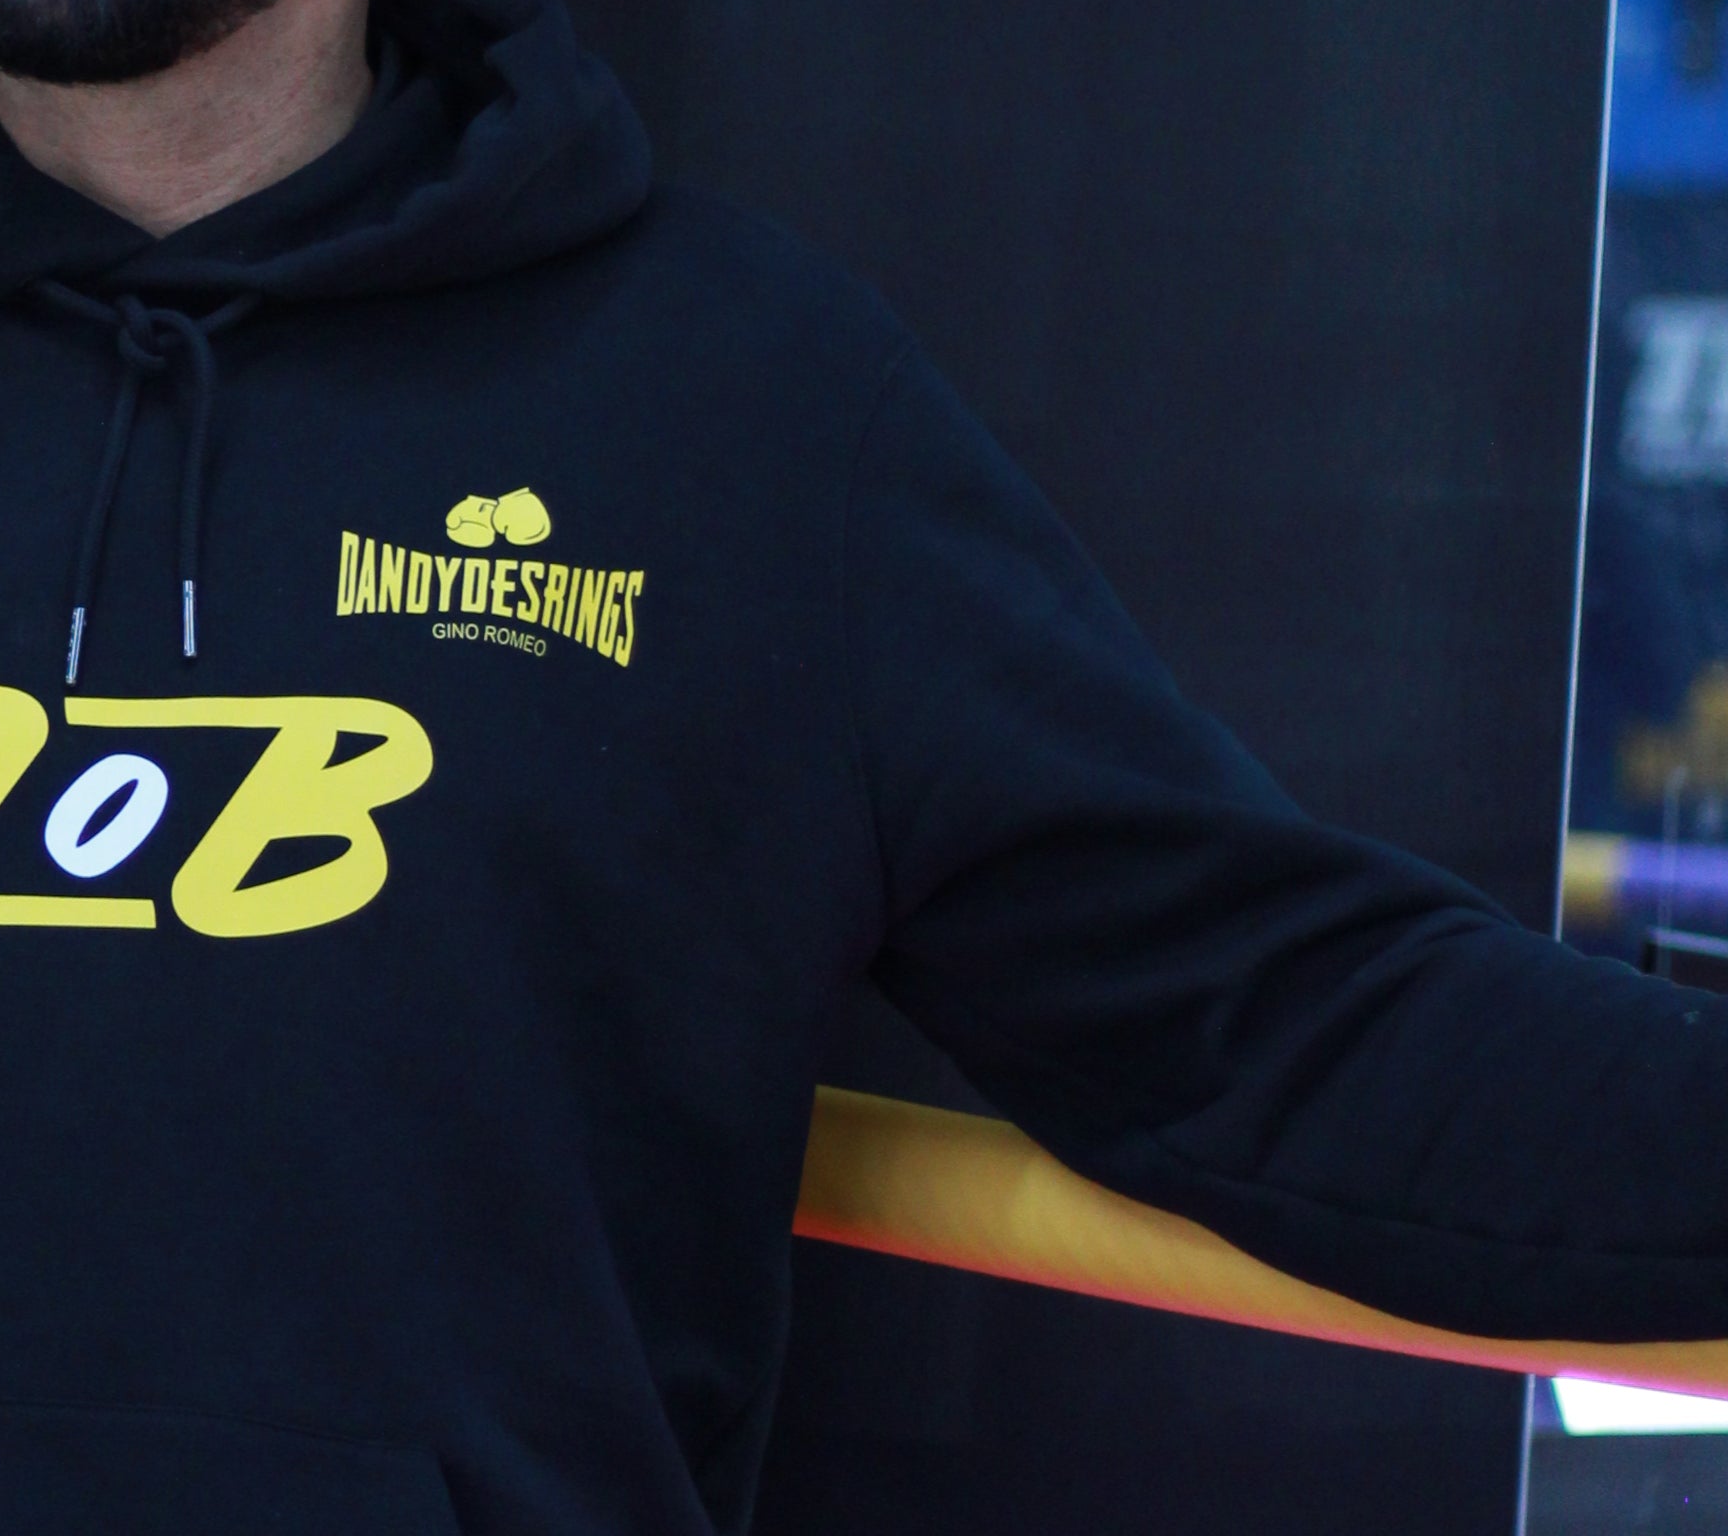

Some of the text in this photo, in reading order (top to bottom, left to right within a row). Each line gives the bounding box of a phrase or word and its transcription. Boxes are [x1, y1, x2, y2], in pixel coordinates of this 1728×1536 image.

[336, 530, 645, 668] DANDYDESRINGS
[432, 622, 547, 657] GINO ROMEO
